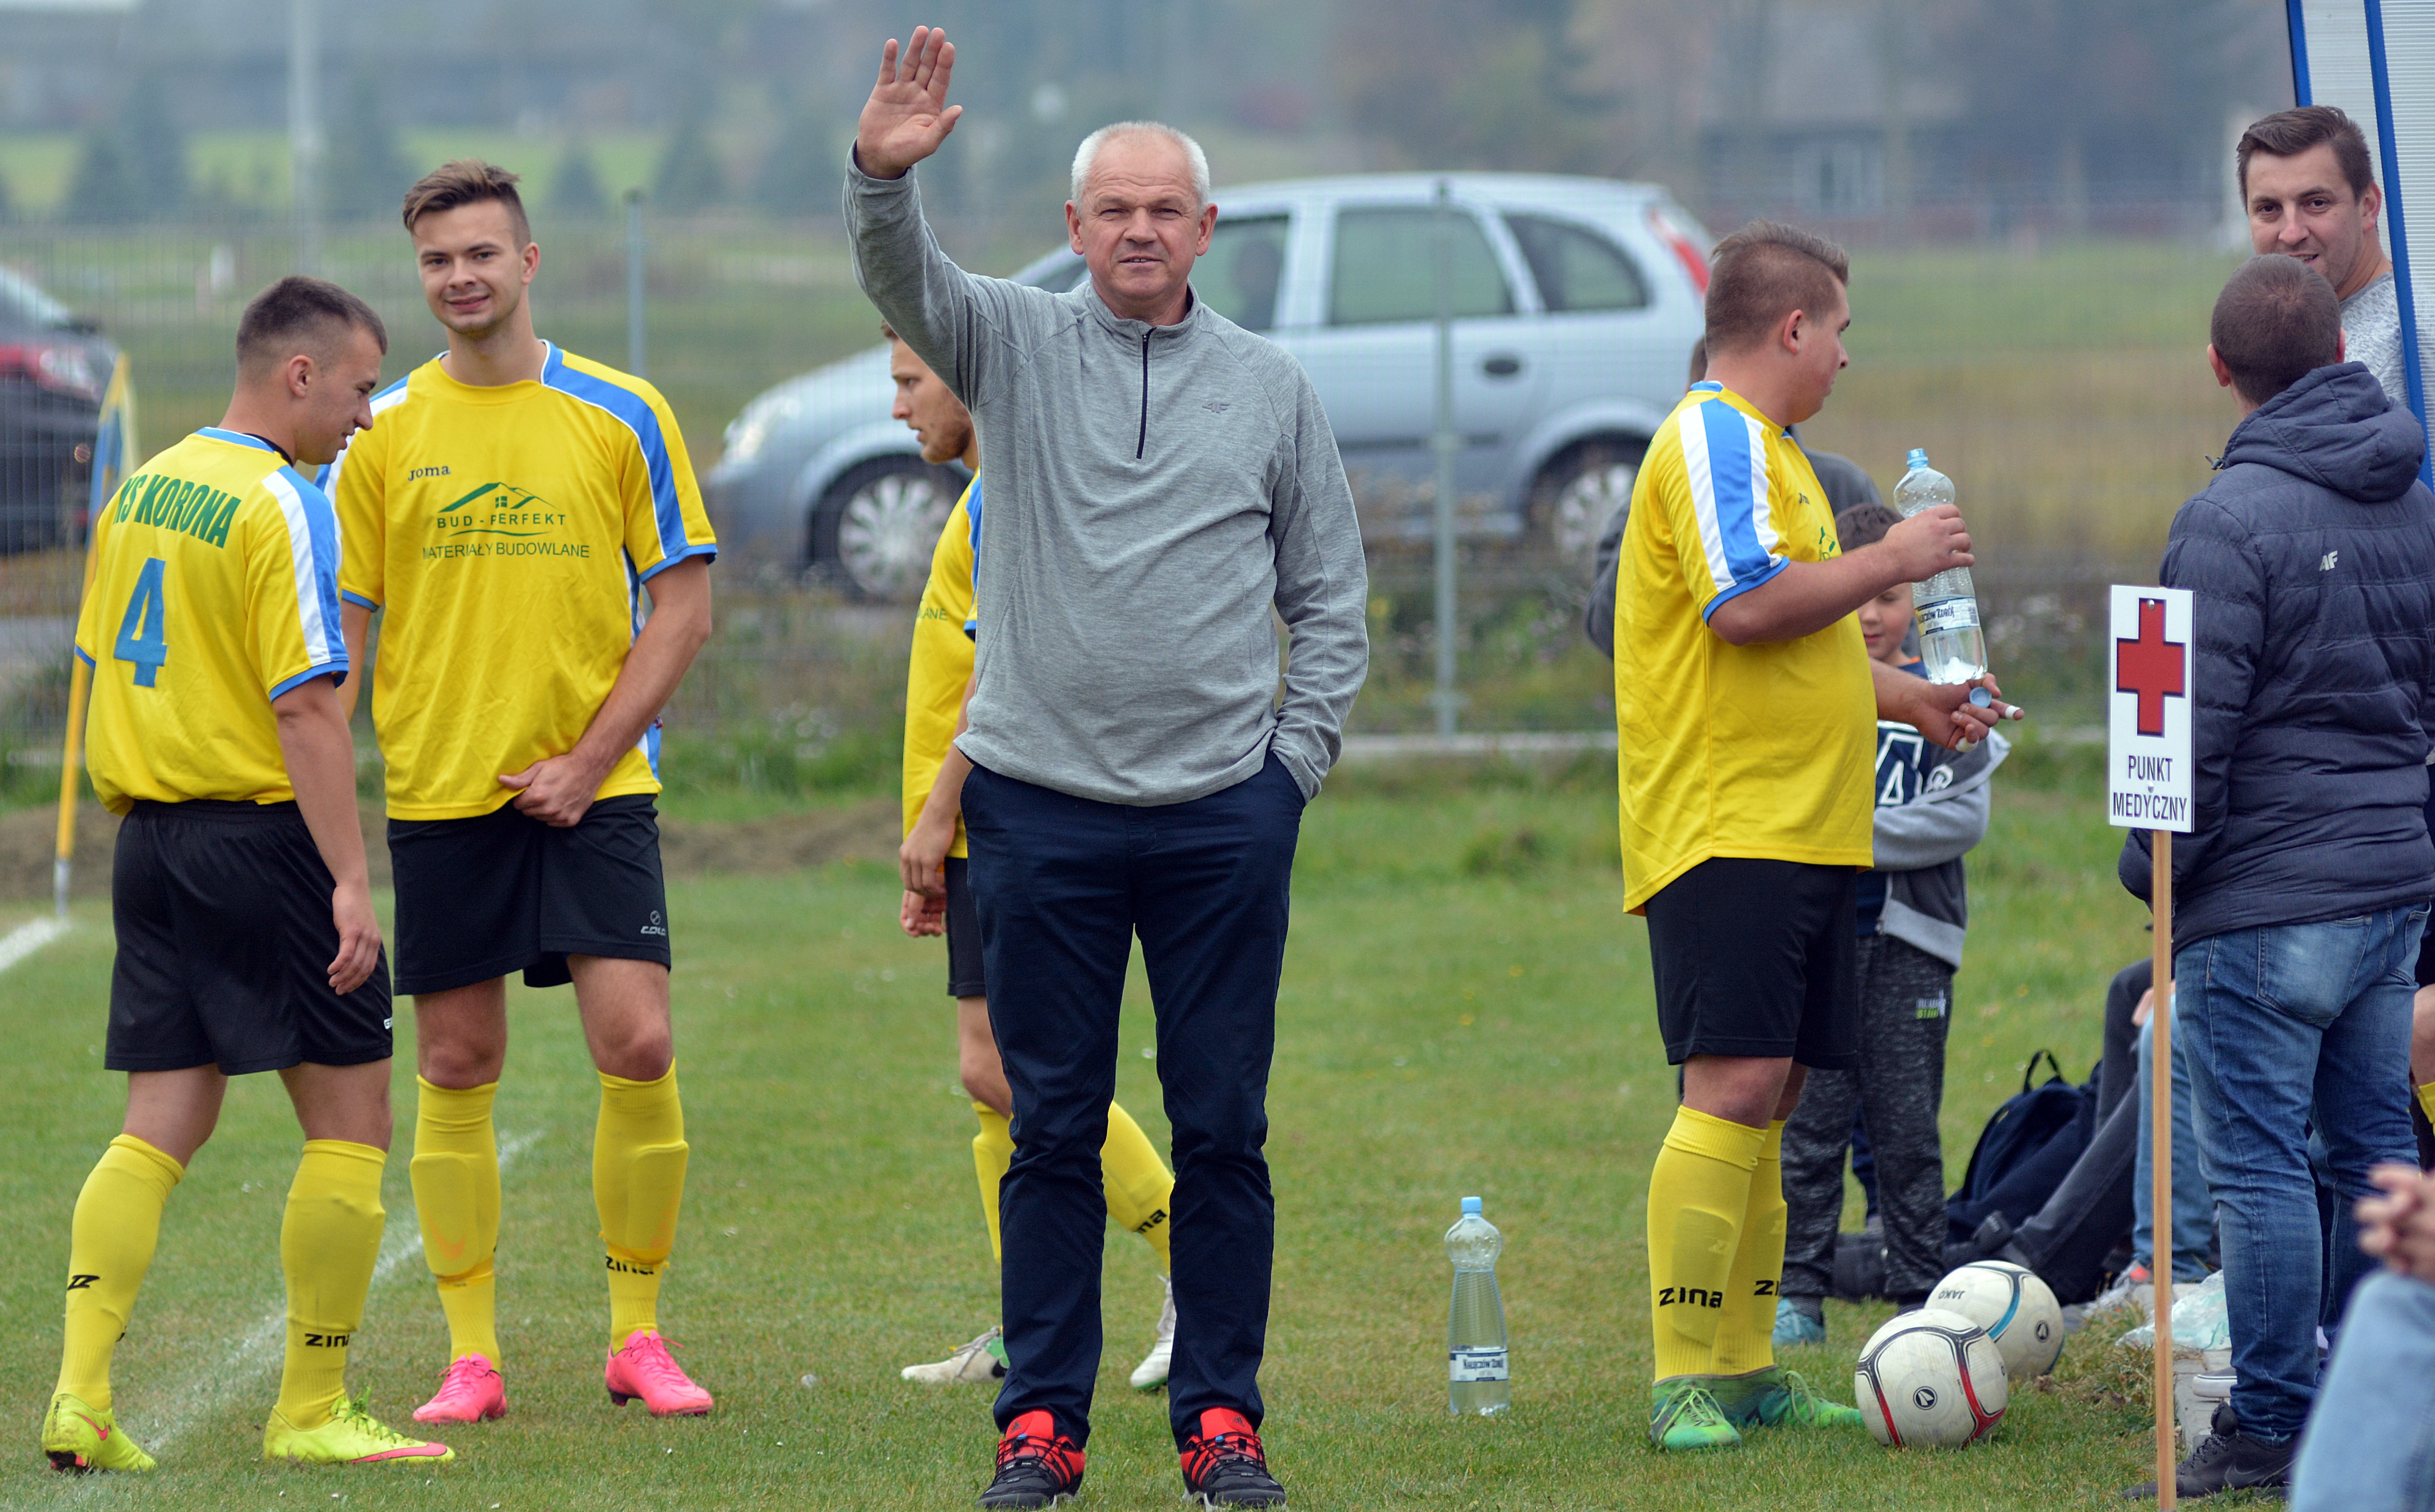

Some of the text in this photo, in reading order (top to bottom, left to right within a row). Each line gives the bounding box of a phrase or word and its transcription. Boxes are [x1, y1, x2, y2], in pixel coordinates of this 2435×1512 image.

[134, 474, 241, 549] KORONA
[437, 515, 473, 529] BUD
[490, 513, 566, 525] PERFEKT
[422, 542, 590, 559] MATERIAŁY BUDOWLANE
[113, 557, 168, 688] 4
[2128, 755, 2173, 782] PUNKT
[2113, 792, 2188, 822] MEDYCZNY
[1938, 1289, 1966, 1300] JAKO
